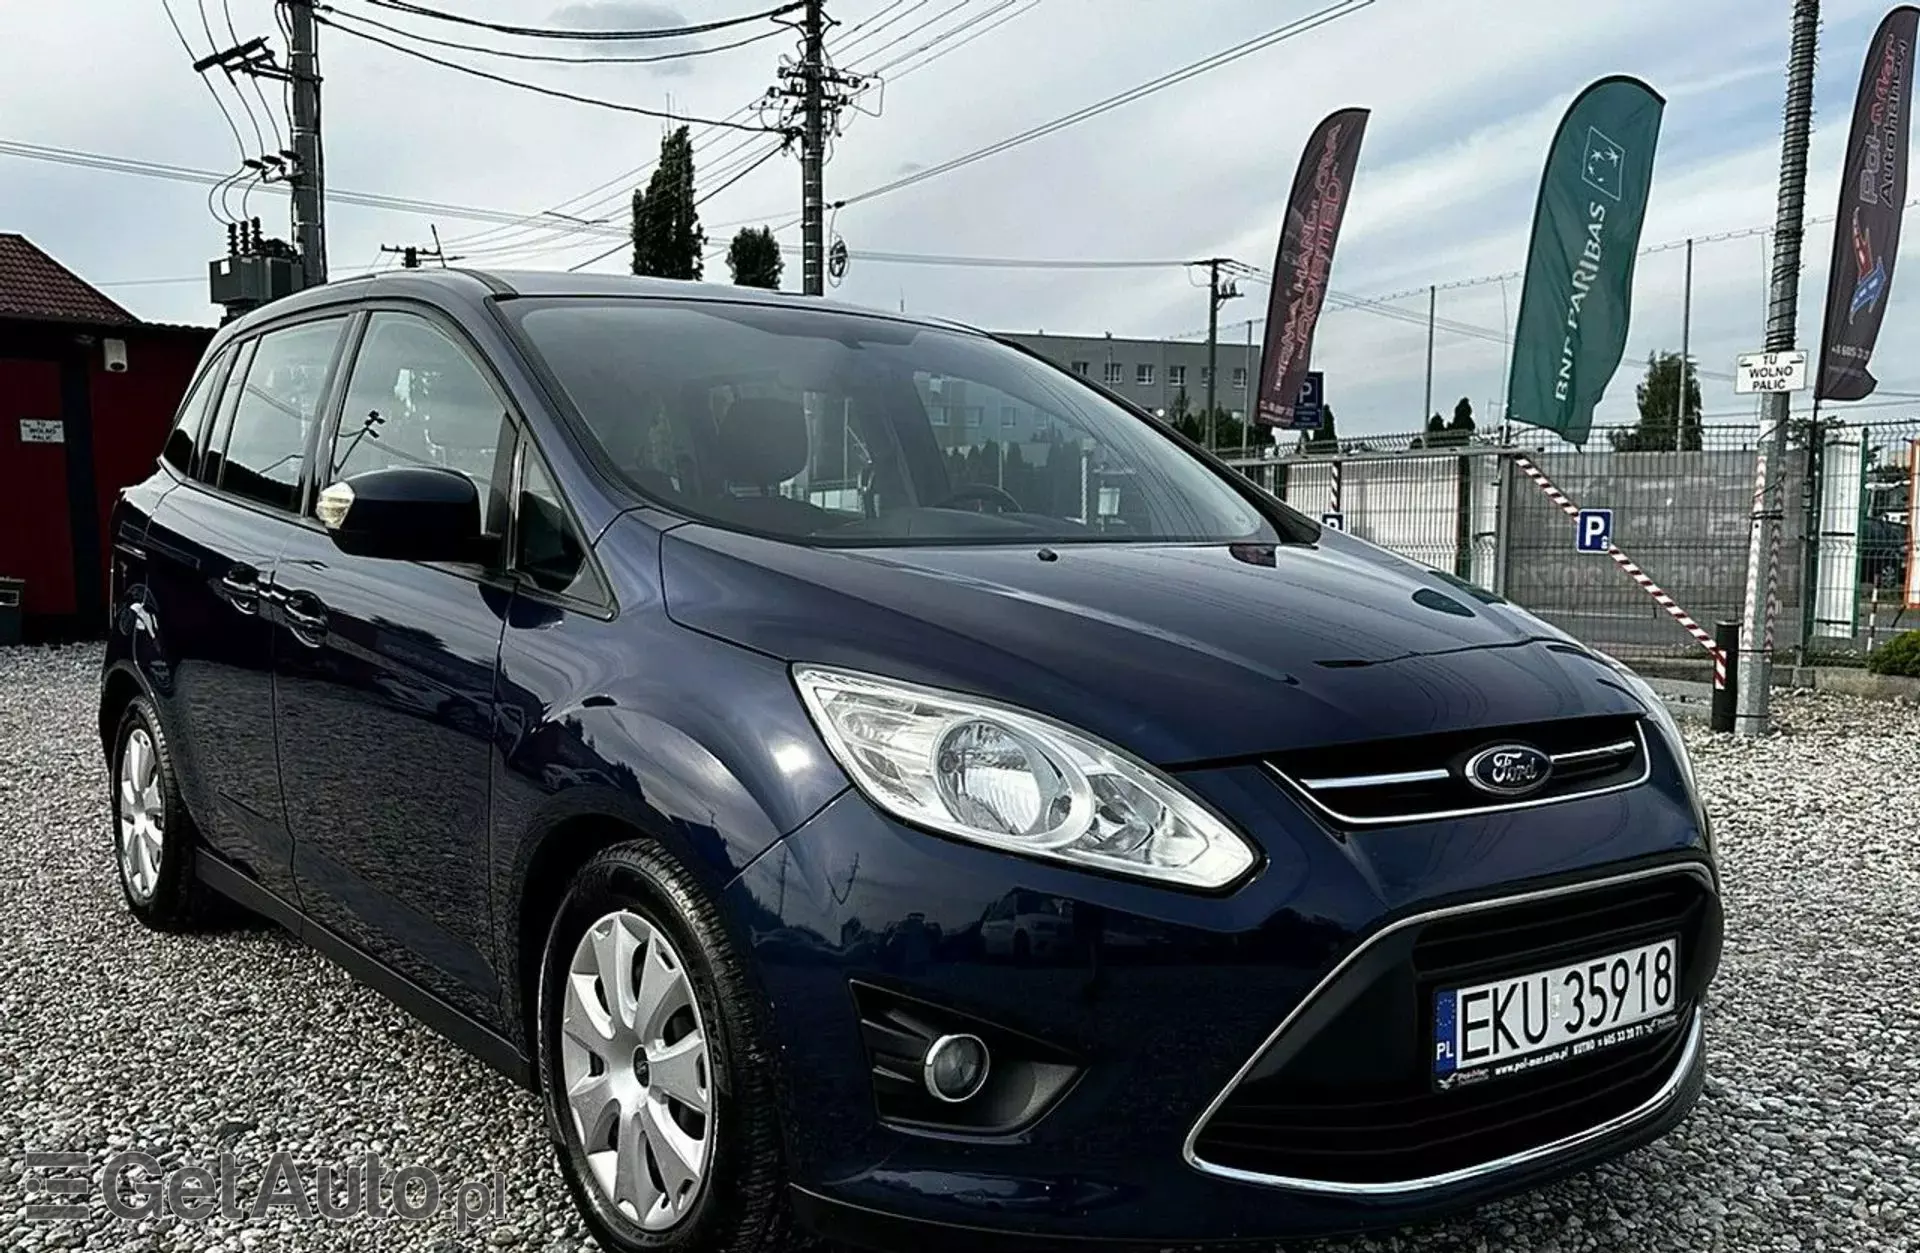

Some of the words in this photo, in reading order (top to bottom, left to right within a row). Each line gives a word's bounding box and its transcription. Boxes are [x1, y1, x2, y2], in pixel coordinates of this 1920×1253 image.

[1567, 201, 1606, 330] PARIBAS
[1749, 366, 1793, 378] WOLNO
[1763, 355, 1778, 365] TU
[1585, 515, 1605, 546] P
[1492, 752, 1537, 782] Ford
[1461, 976, 1549, 1062] EKU
[1563, 946, 1672, 1034] 35918
[1436, 1042, 1454, 1061] PL
